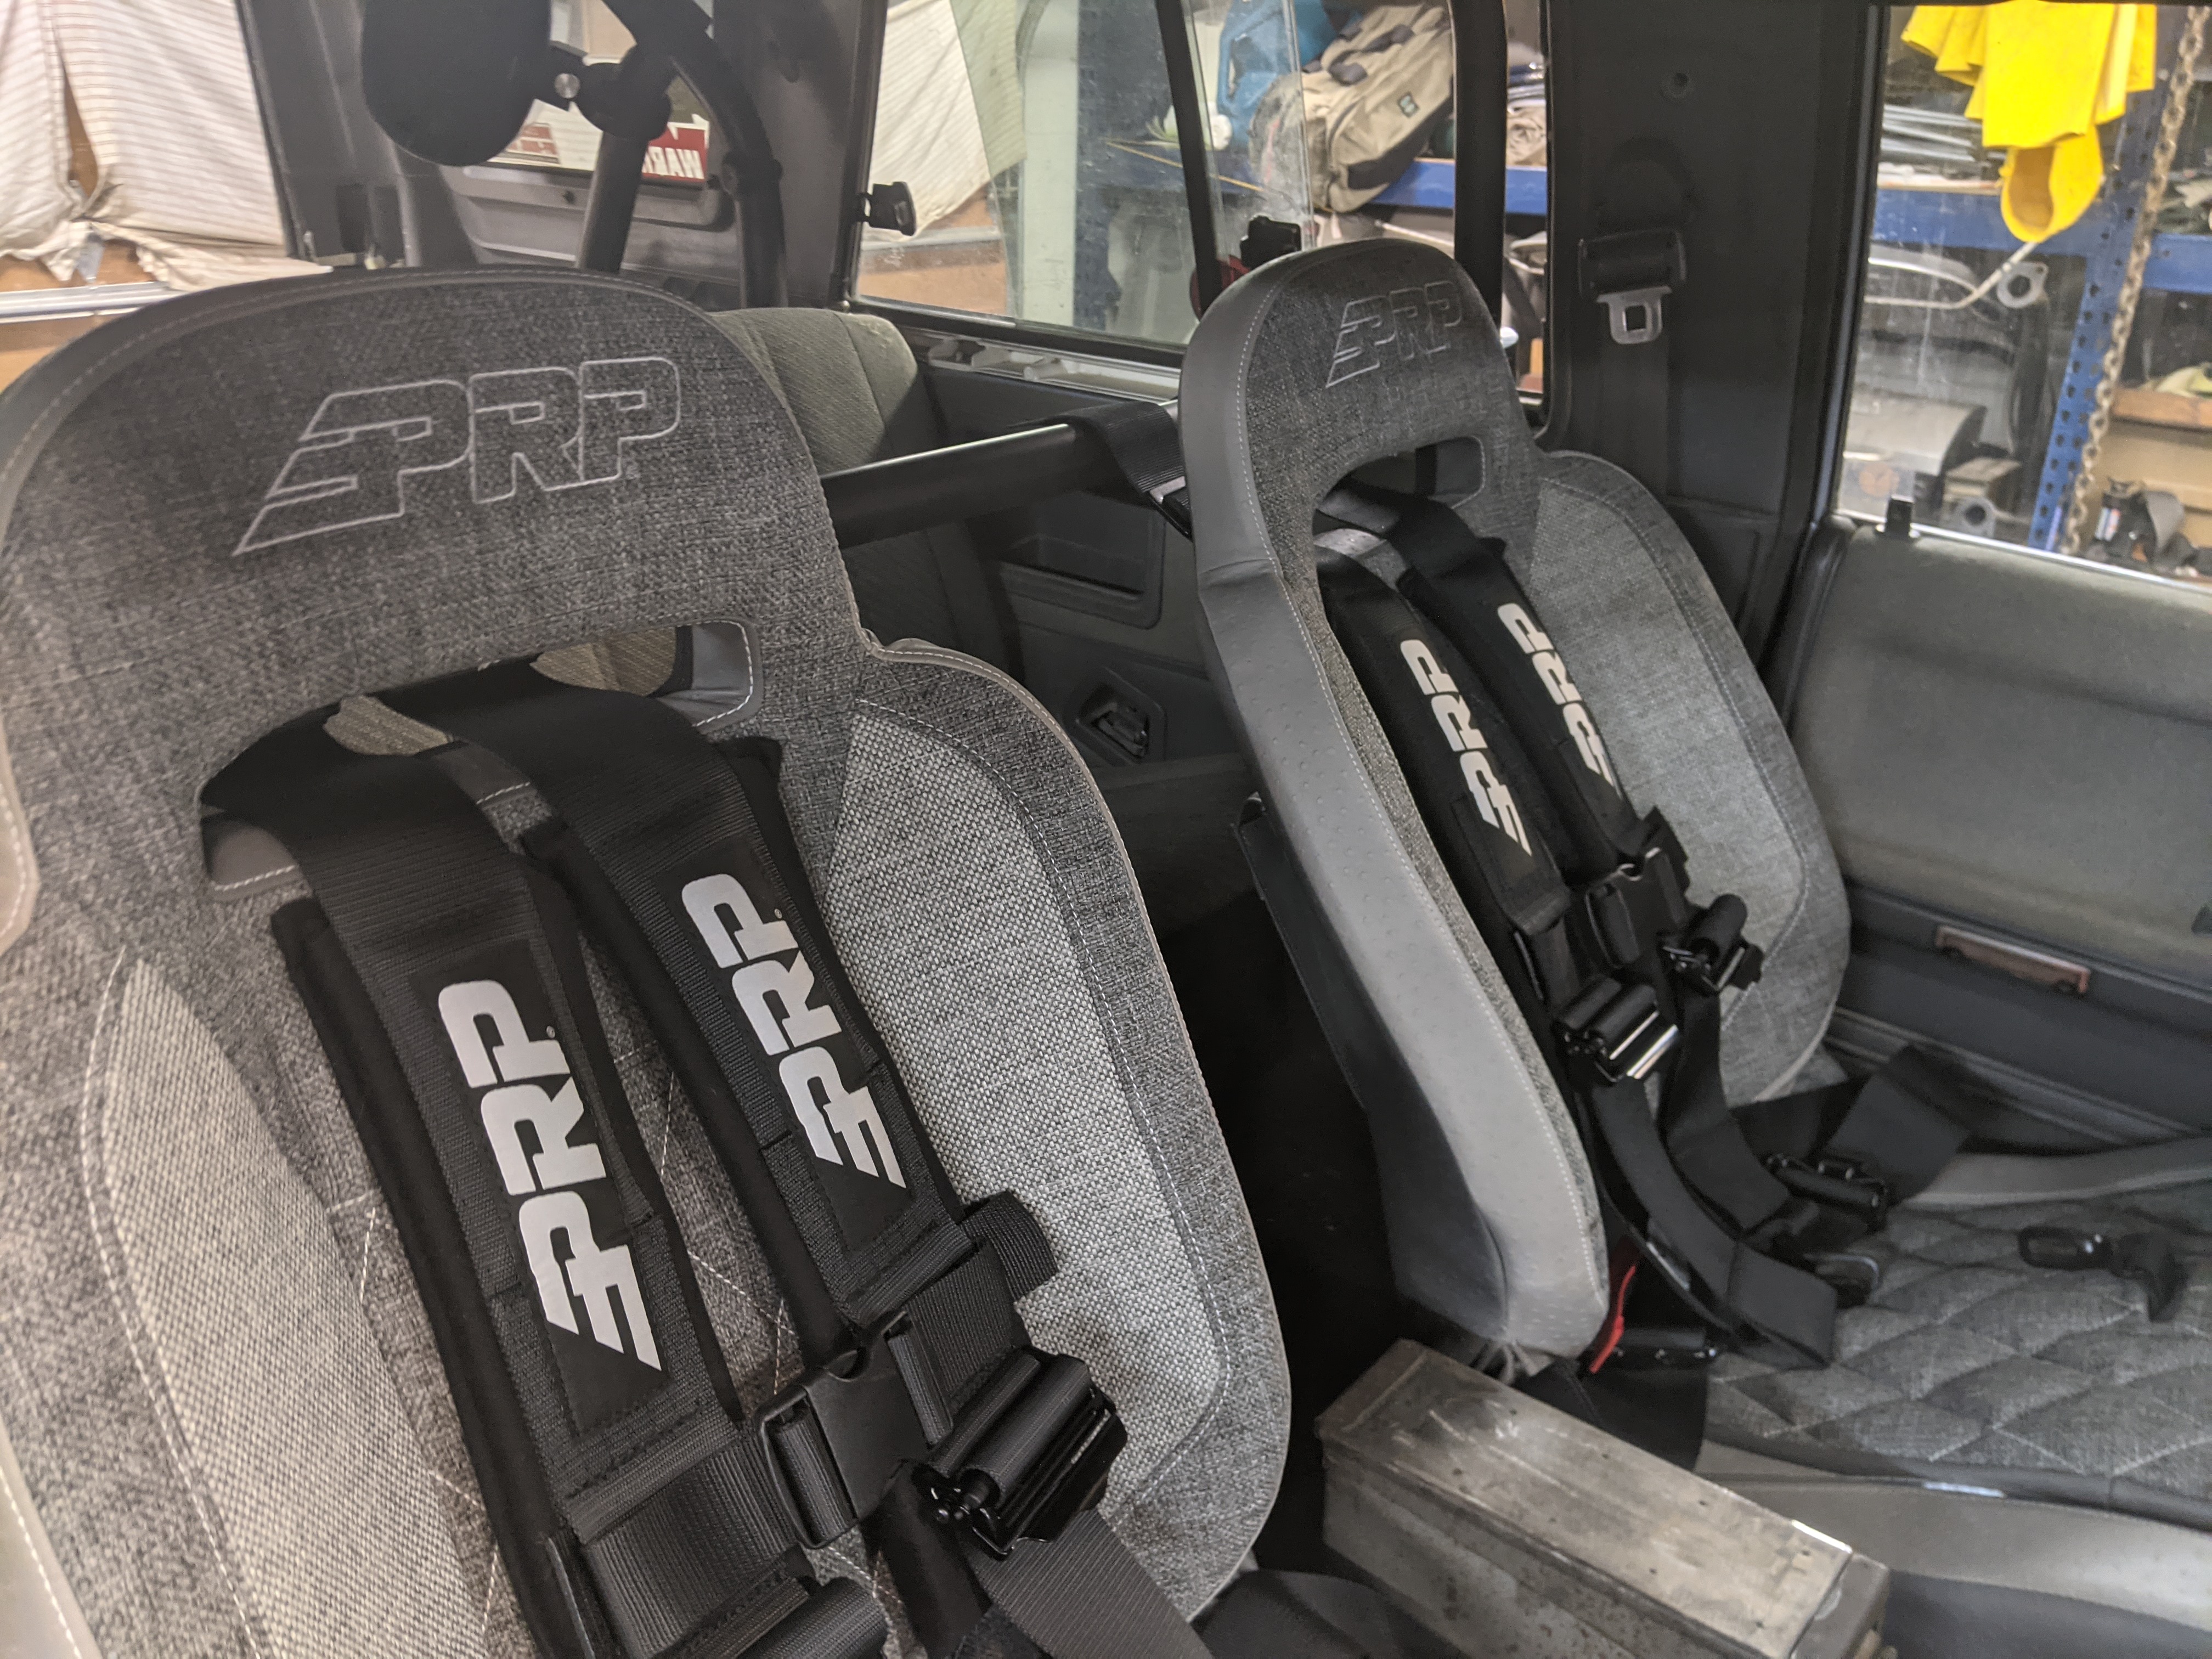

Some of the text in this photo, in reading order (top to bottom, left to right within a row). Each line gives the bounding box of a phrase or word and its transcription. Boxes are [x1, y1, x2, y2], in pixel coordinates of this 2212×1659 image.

[1325, 280, 1463, 389] PRP
[233, 357, 681, 556] PRP
[1400, 639, 1532, 856] PRP
[1497, 603, 1623, 799] PRP
[681, 873, 907, 1189] PRP
[438, 980, 662, 1371] PRP
